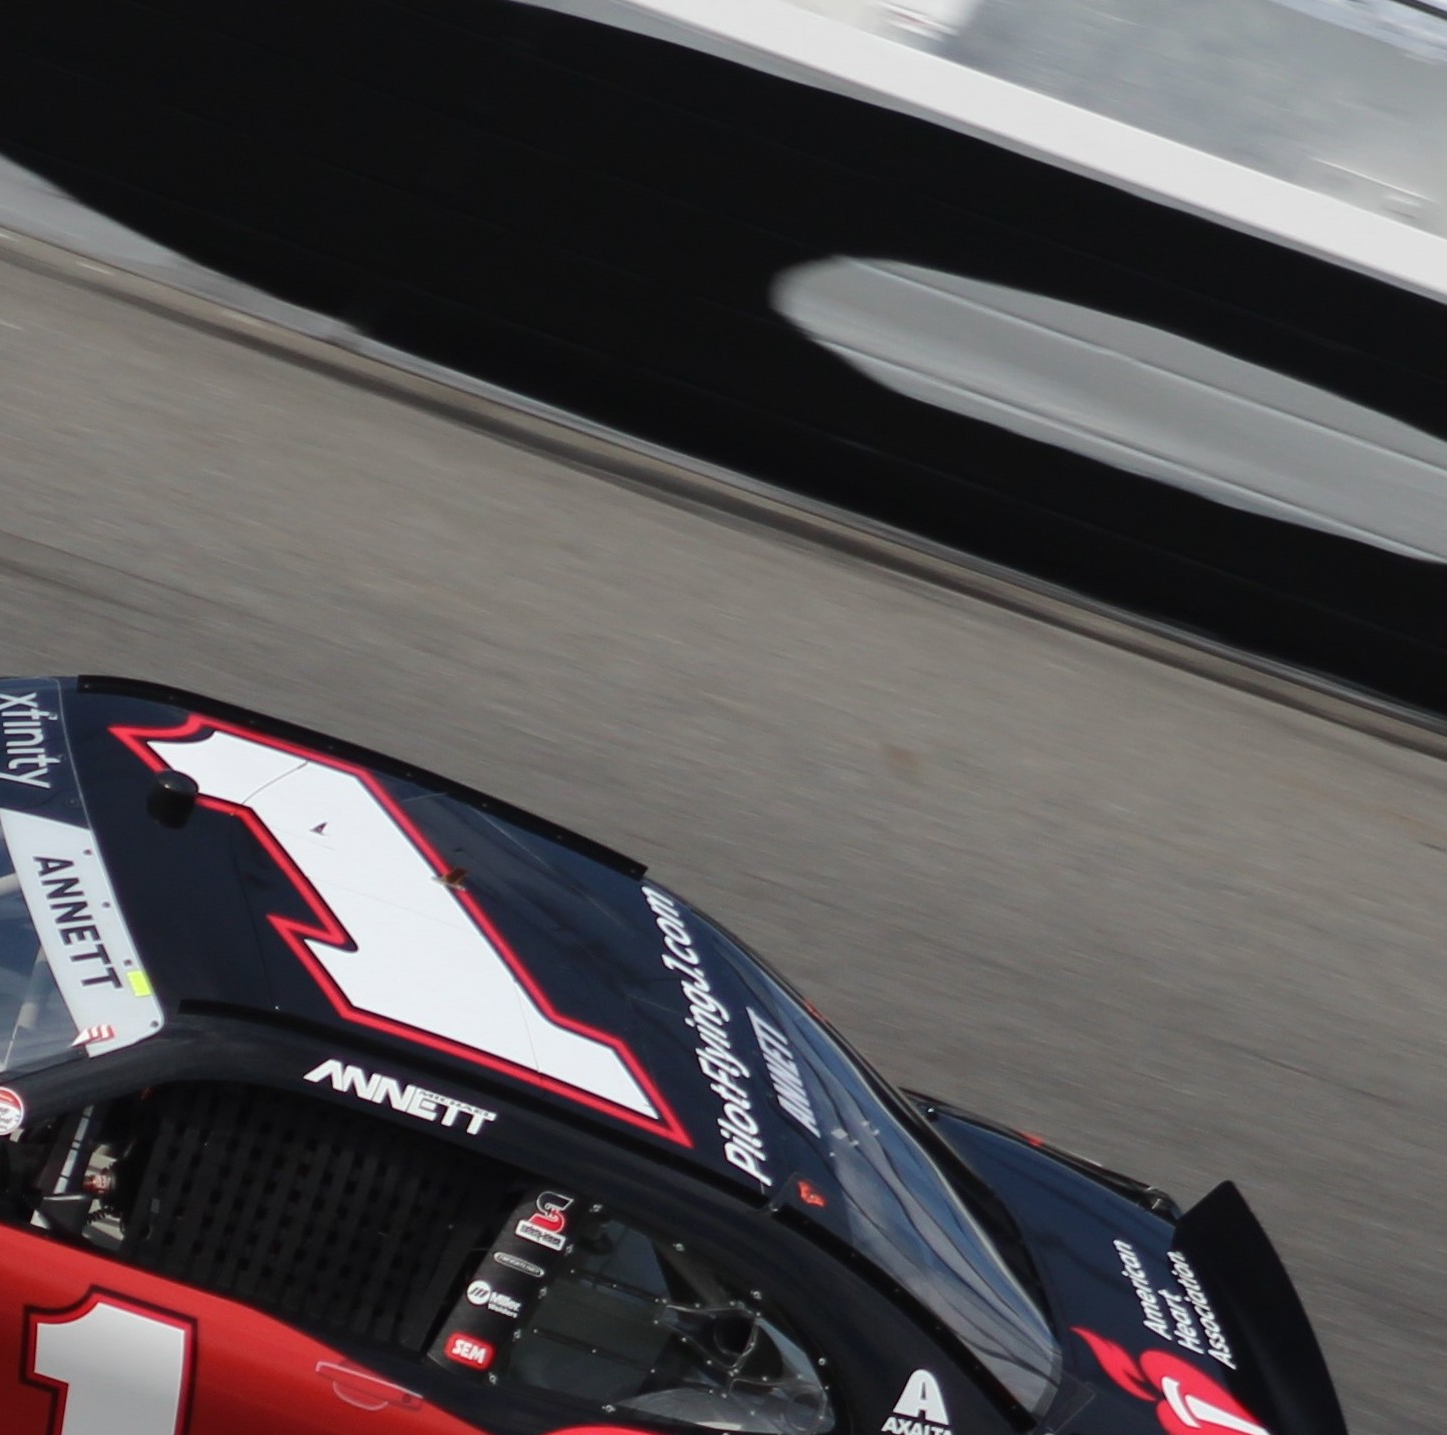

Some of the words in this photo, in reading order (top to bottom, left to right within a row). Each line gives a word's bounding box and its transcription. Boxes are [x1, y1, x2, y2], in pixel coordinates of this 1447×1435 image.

[33, 855, 125, 989] ANNETT
[123, 722, 683, 1140] 1
[303, 1059, 498, 1135] ANNETT
[745, 1006, 820, 1138] ANNETT
[1113, 1239, 1172, 1341] American
[1158, 1289, 1204, 1354] Heart
[1167, 1251, 1237, 1370] Association
[452, 1339, 487, 1364] SEM
